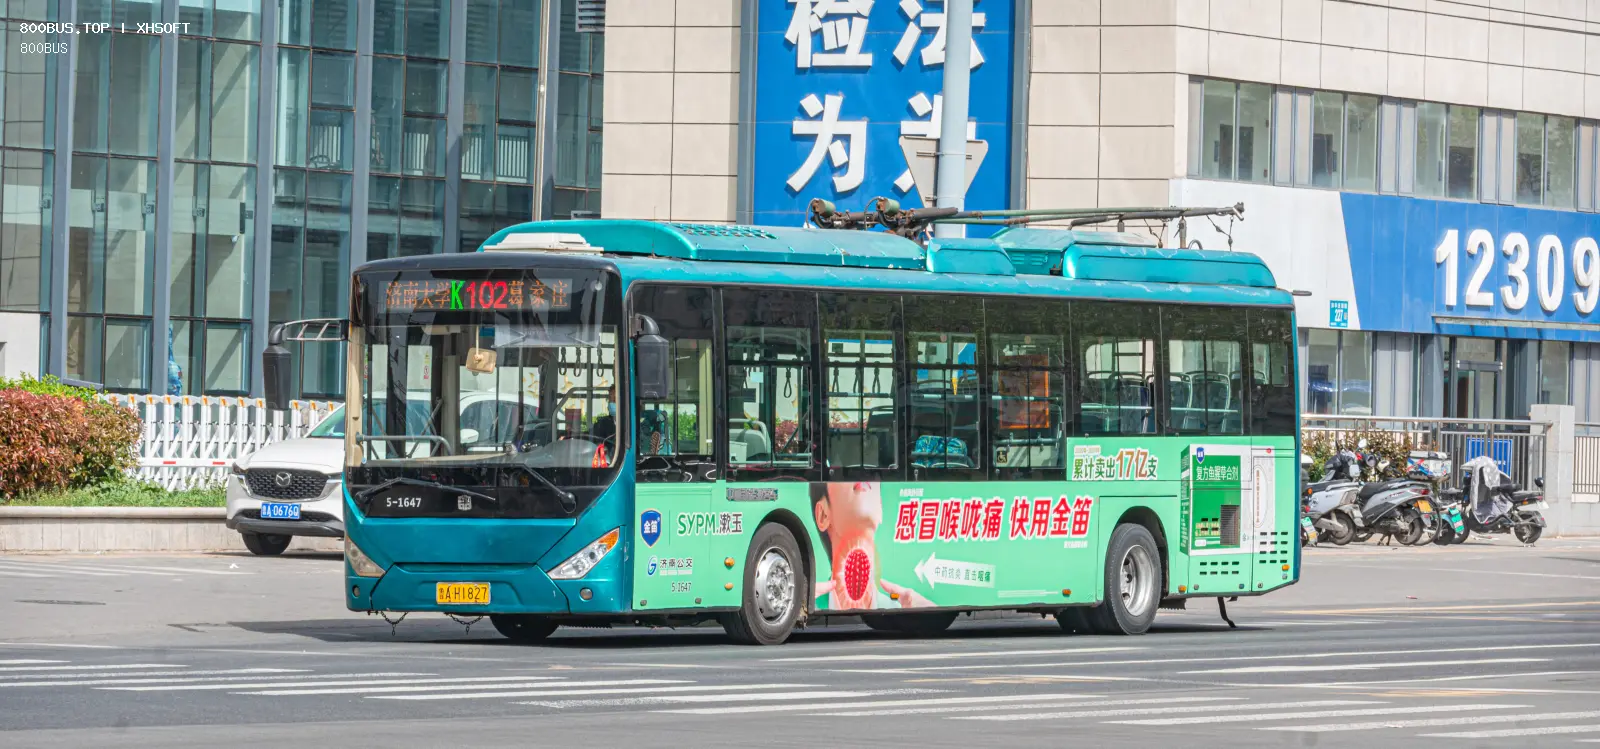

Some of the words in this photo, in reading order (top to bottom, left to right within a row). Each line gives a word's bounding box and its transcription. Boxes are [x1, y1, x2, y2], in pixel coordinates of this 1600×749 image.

[1436, 228, 1600, 314] 12309
[386, 281, 450, 309] 济南大学
[450, 280, 508, 310] K102
[508, 280, 568, 307] 葛家庄
[1073, 449, 1157, 479] 累计卖出17亿支
[1196, 465, 1239, 481] 复方鱼腥草合剂
[386, 497, 422, 507] 5-1647
[894, 498, 1004, 541] 感冒喉咙痛
[1009, 496, 1093, 538] 快用金笛
[644, 521, 658, 534] 金笛
[660, 558, 693, 568] 济南公交
[935, 566, 961, 580] 中药抗炎
[671, 582, 692, 592] 5-1647
